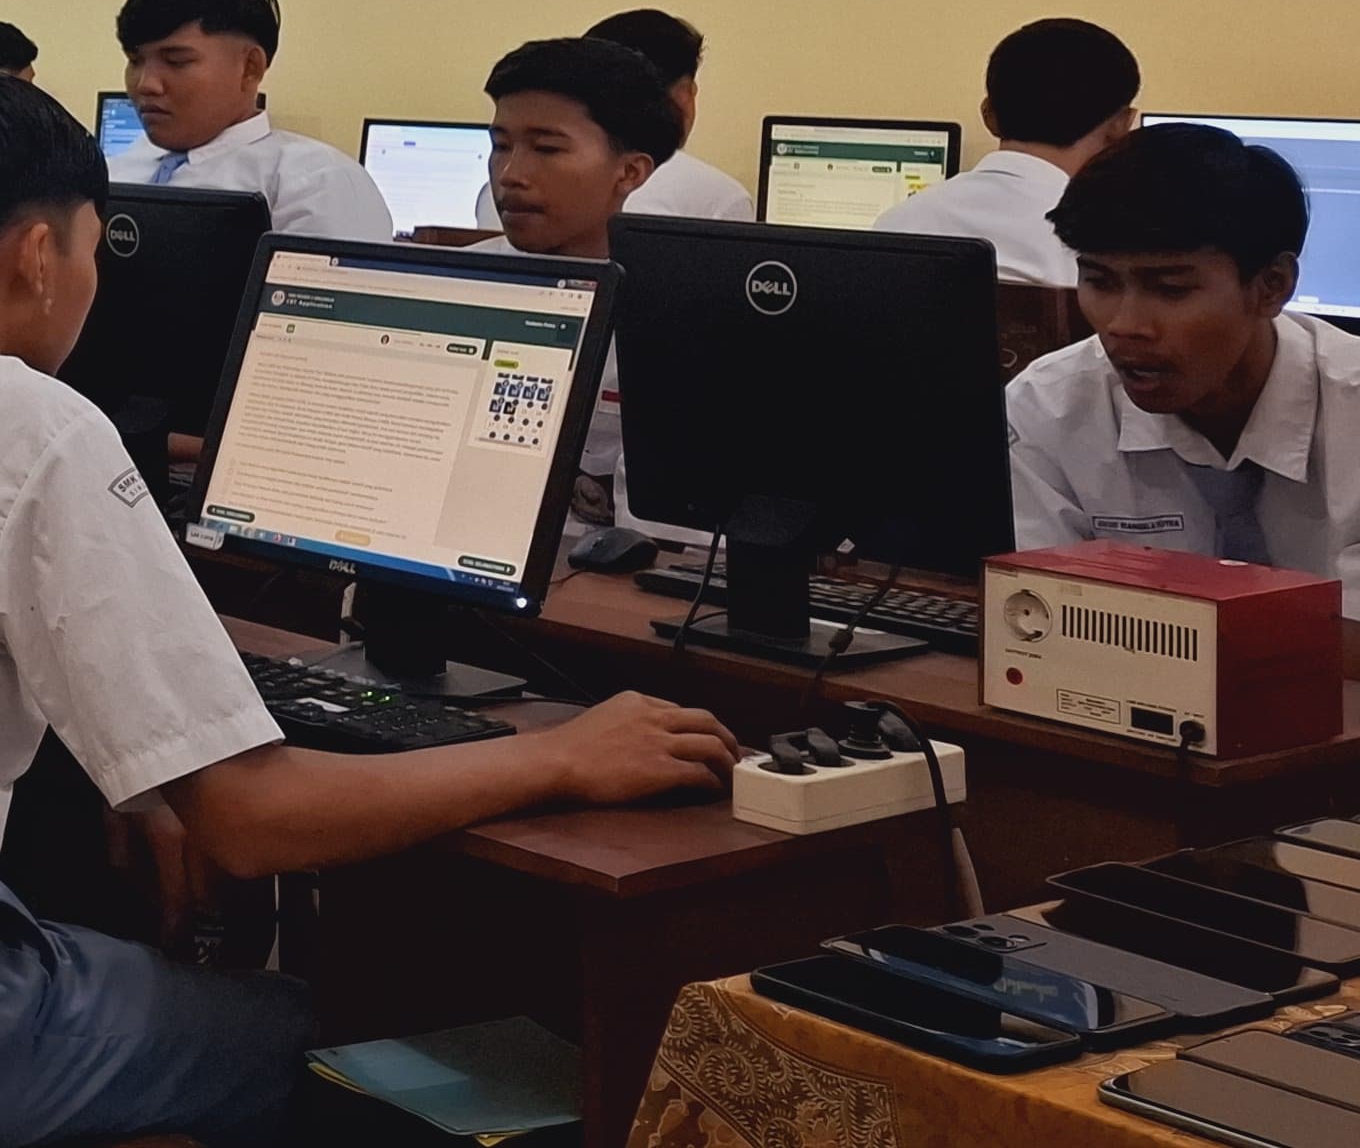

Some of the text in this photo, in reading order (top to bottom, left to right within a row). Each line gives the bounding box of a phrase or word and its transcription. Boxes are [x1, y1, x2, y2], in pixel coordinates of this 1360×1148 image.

[110, 230, 136, 242] DELL
[751, 280, 791, 295] DELL
[118, 474, 138, 493] SMK
[329, 558, 357, 574] DELL
